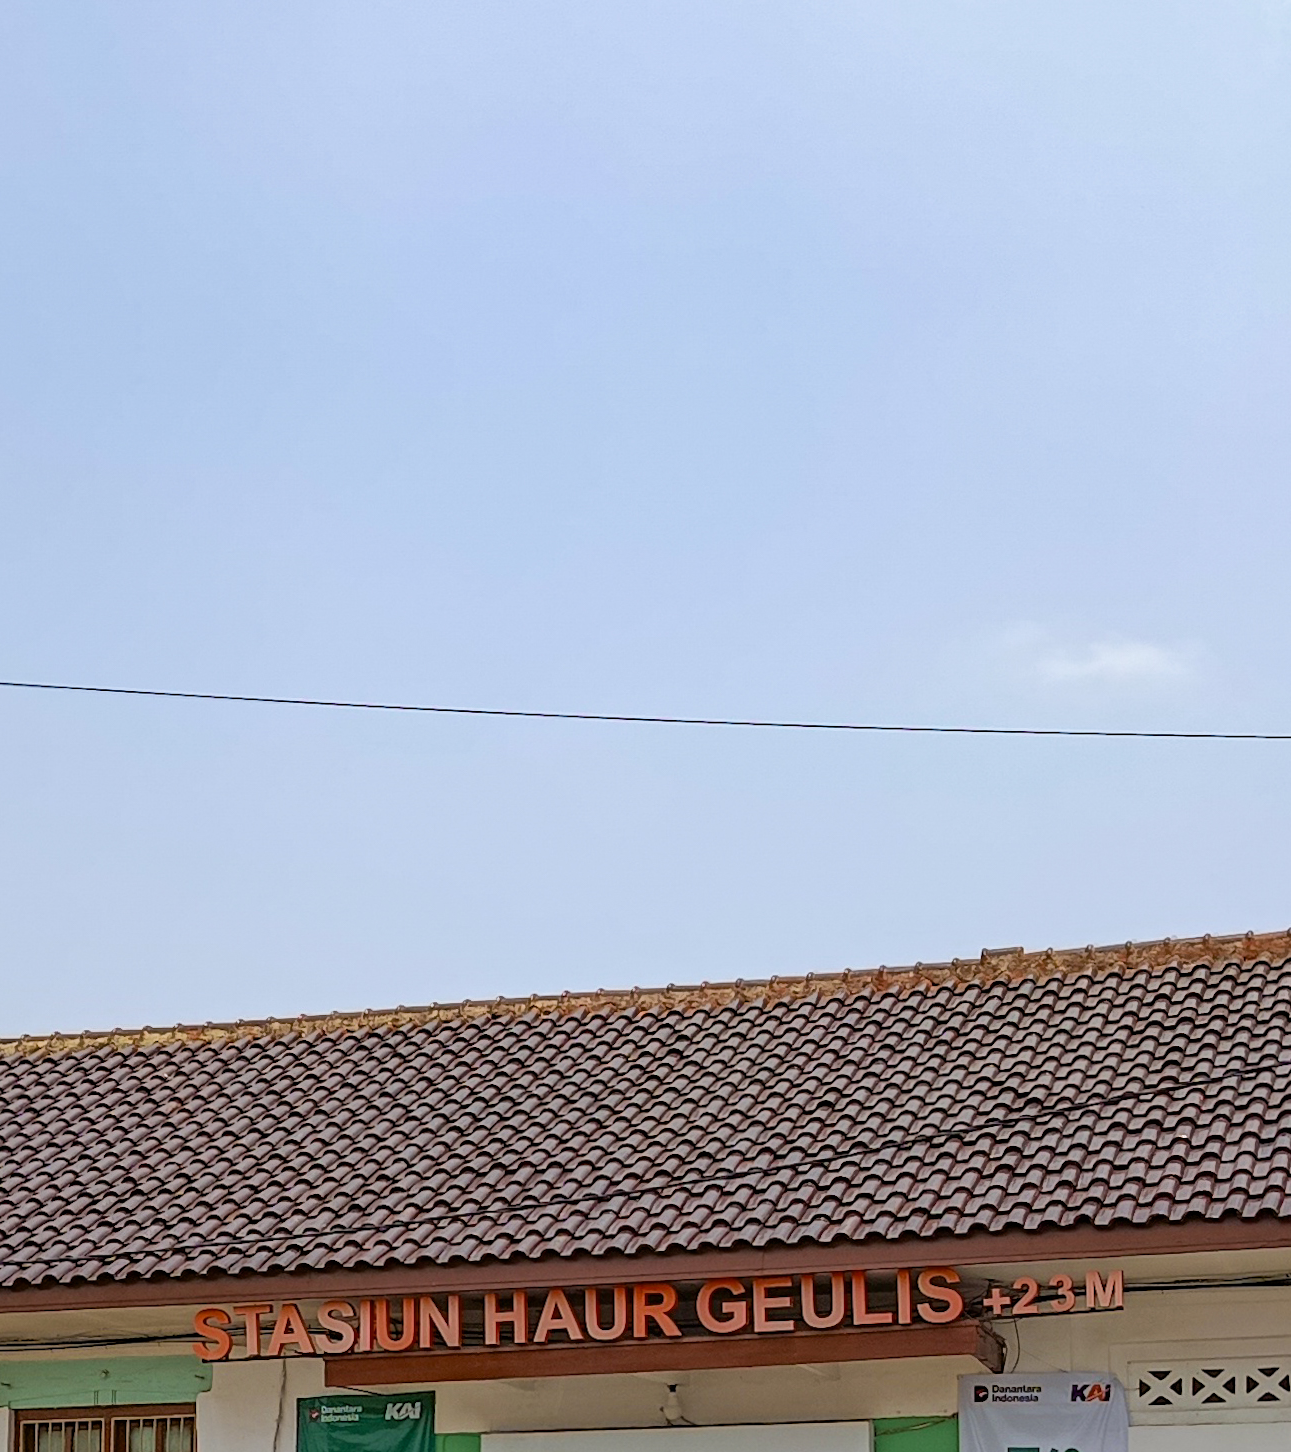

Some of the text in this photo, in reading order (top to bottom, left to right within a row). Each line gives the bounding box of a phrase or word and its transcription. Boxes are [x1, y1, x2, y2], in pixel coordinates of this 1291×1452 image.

[192, 1293, 462, 1361] STASIUN
[484, 1281, 682, 1345] HAUR
[695, 1267, 963, 1334] GEULIS
[992, 1385, 1042, 1393] Danantara
[992, 1394, 1039, 1402] Indonesia
[1070, 1384, 1111, 1402] KAI
[384, 1401, 421, 1420] KAI
